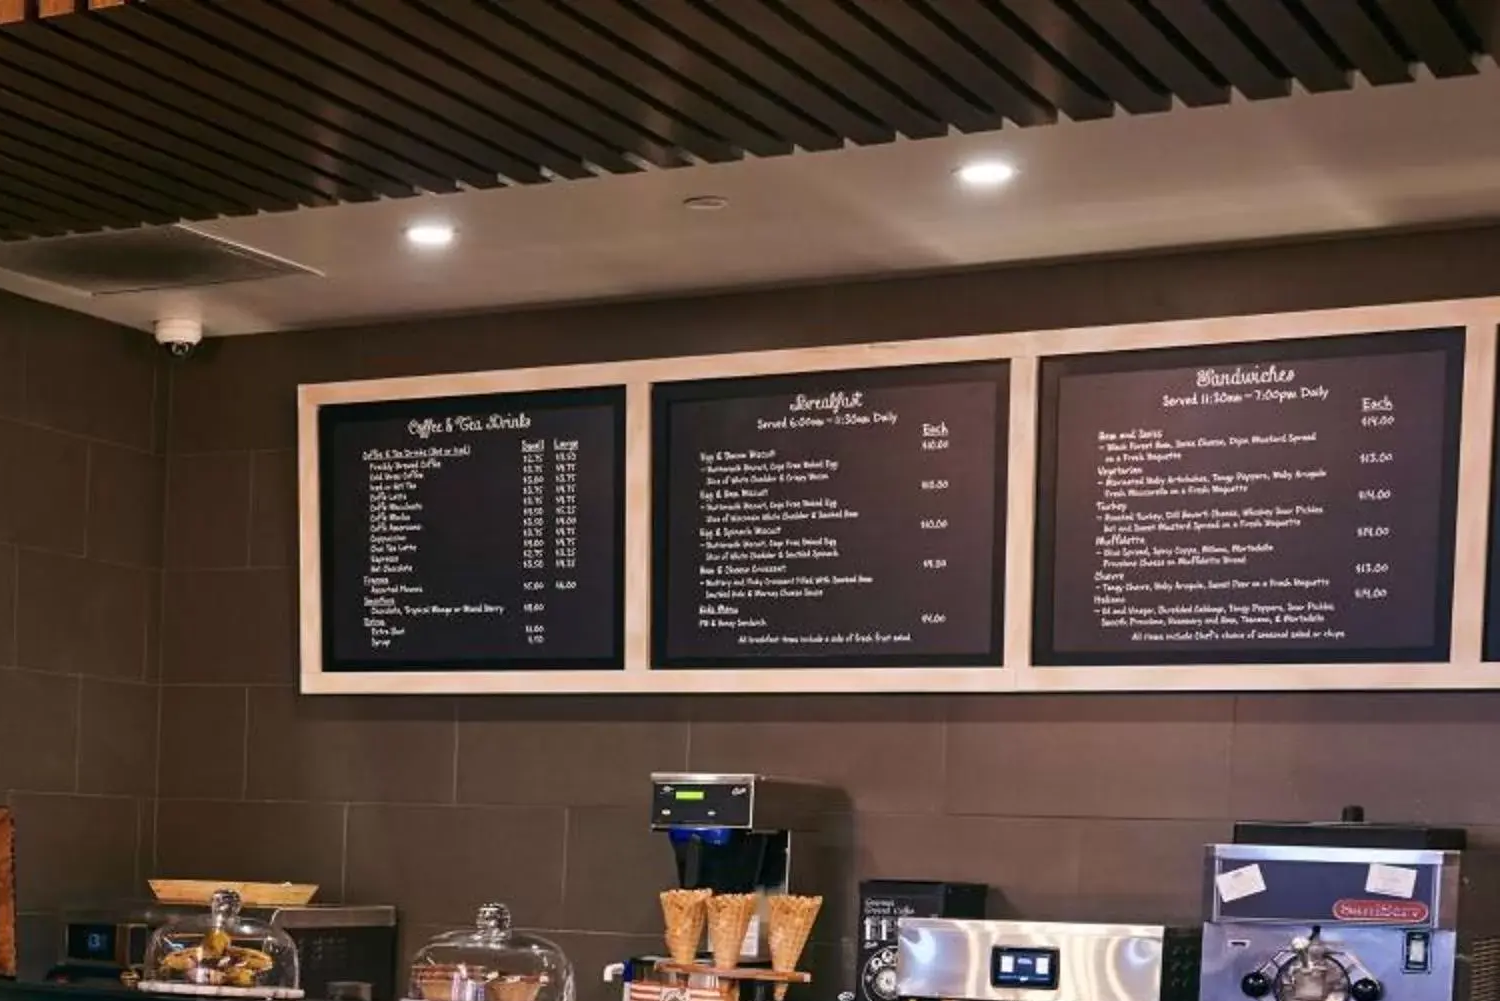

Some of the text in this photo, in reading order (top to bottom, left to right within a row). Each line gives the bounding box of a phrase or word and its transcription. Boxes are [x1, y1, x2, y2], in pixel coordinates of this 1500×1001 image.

[1196, 367, 1295, 386] Sandwiches
[790, 393, 863, 415] Breakfast
[1163, 395, 1198, 406] Served
[1300, 387, 1328, 399] Daily
[1362, 397, 1392, 411] Each
[408, 419, 443, 438] Coffee
[486, 413, 531, 430] Drinks
[923, 424, 948, 436] Each
